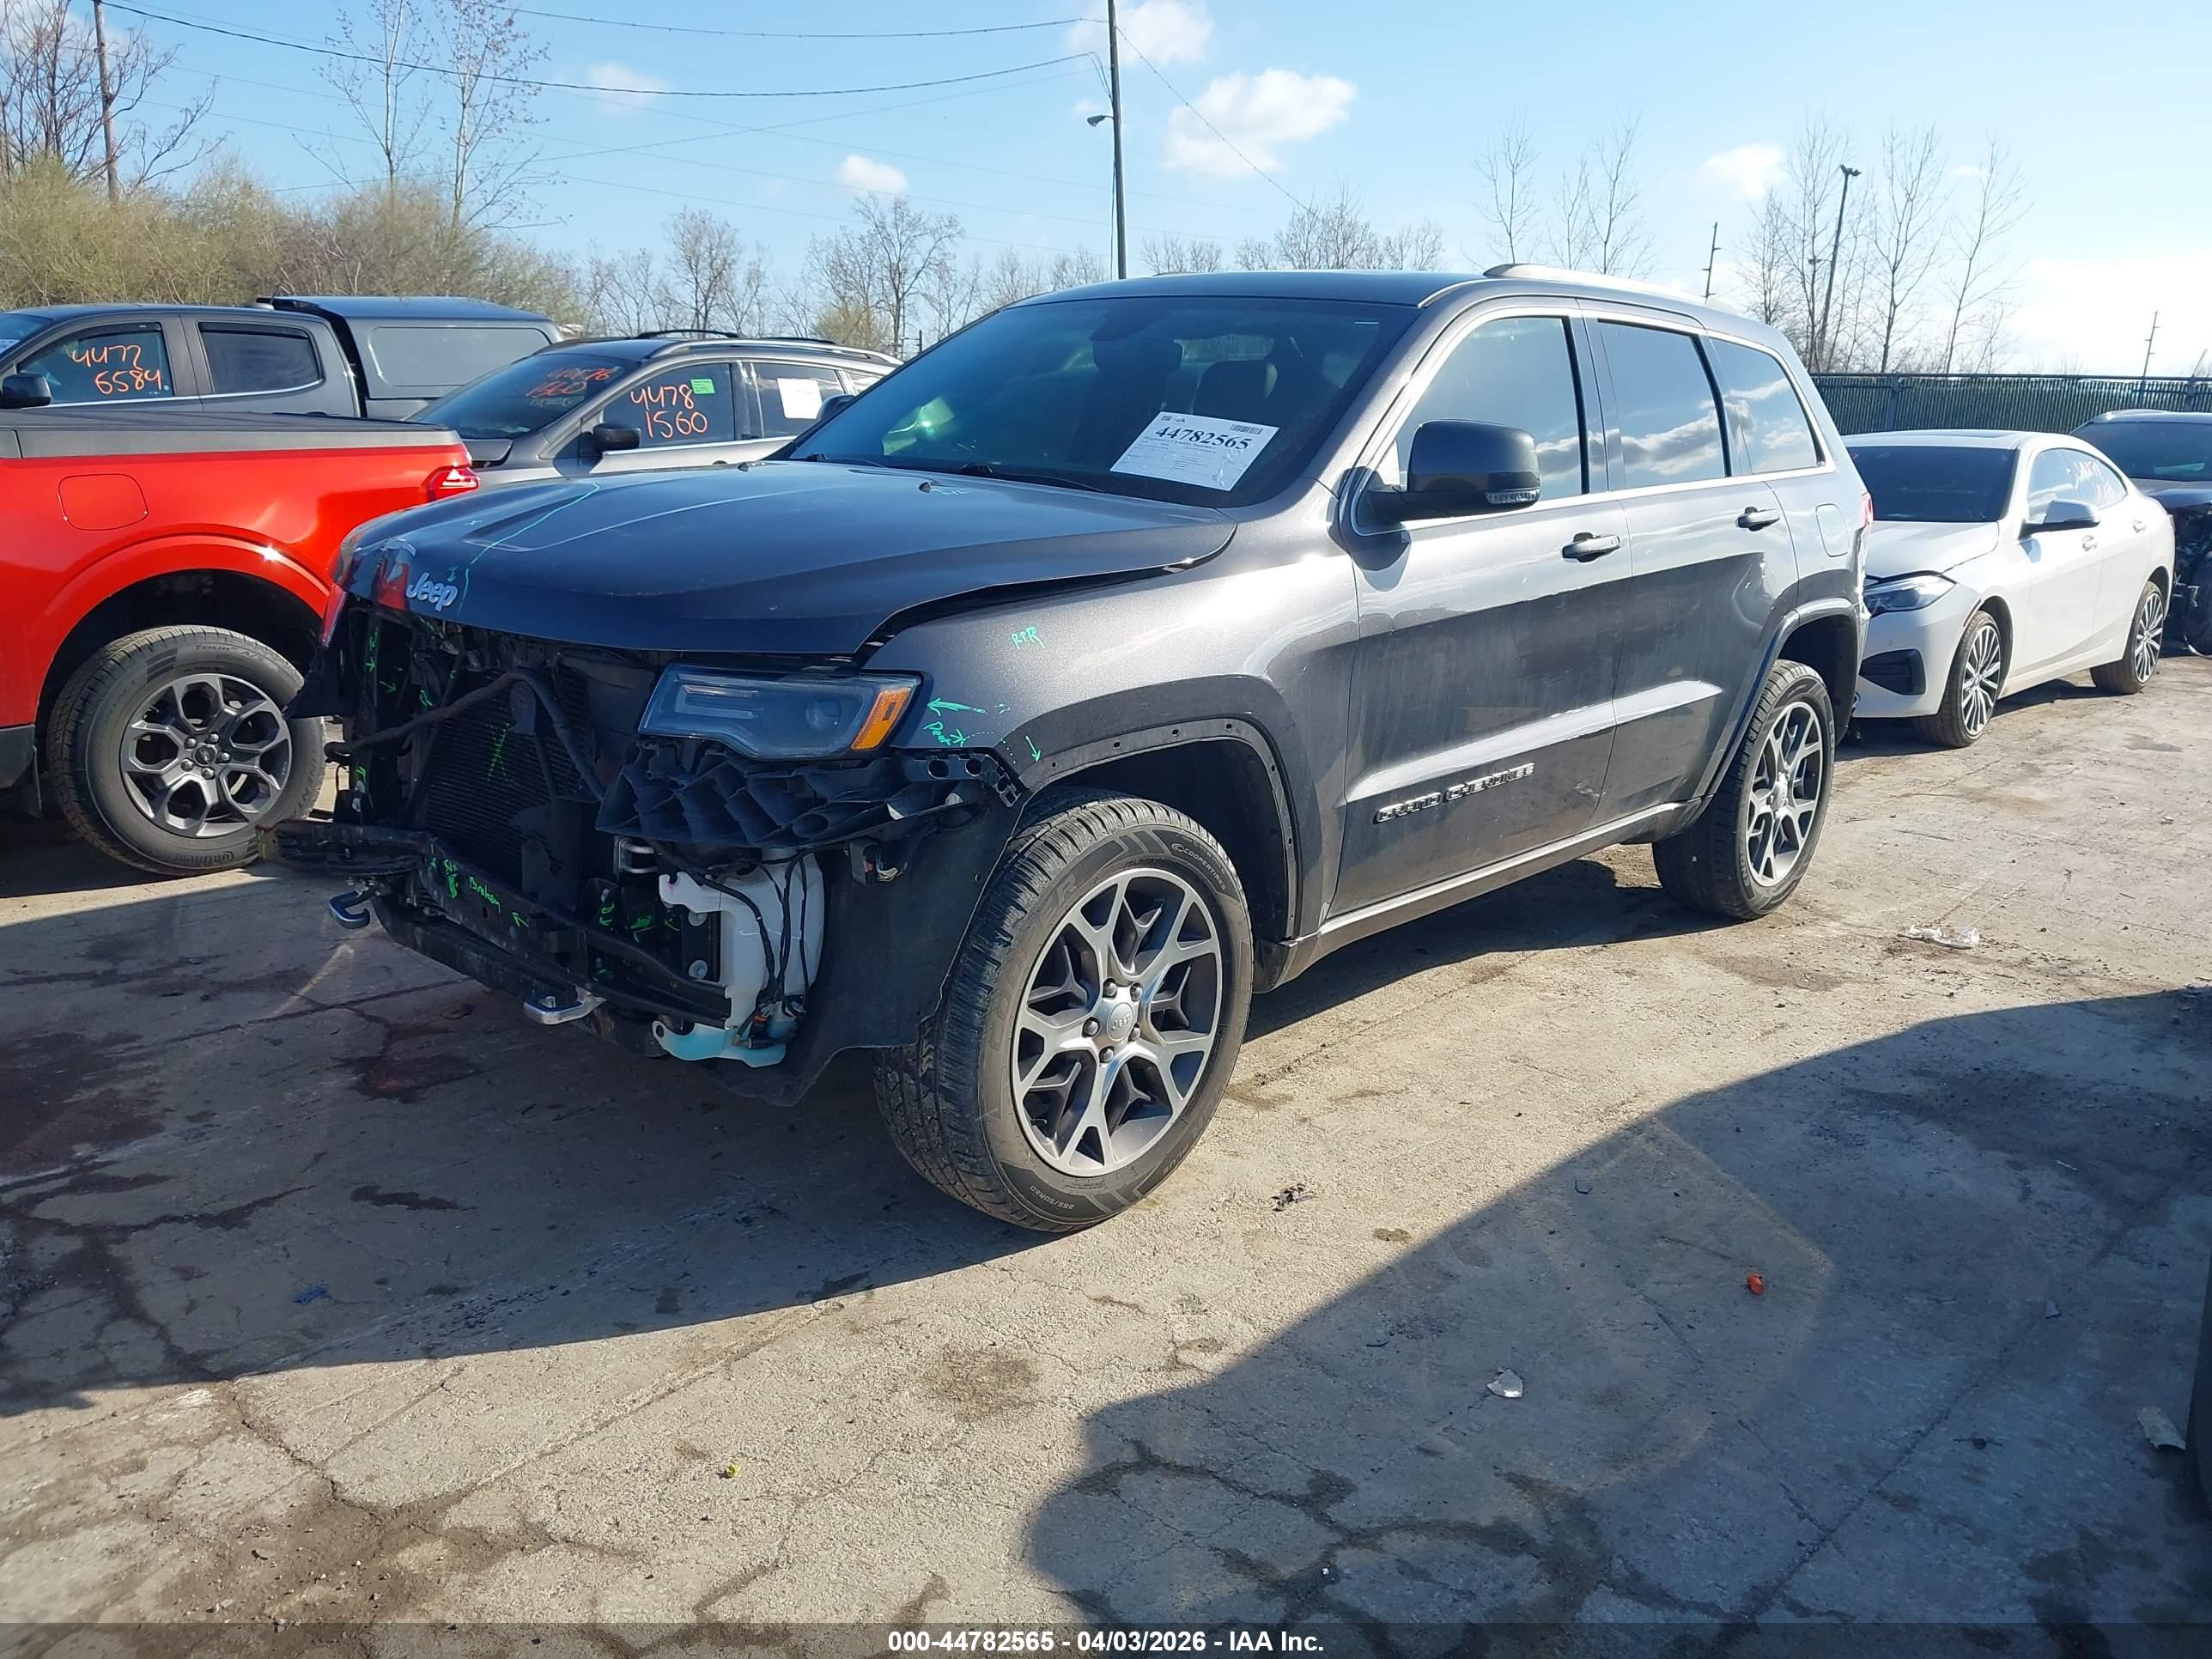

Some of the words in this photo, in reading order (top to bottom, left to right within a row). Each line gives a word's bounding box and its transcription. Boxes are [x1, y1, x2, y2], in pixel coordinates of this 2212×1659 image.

[95, 369, 162, 395] 6584
[630, 384, 695, 411] 4478
[645, 410, 708, 439] 1560
[1155, 426, 1253, 451] 44782565
[405, 572, 459, 612] Jeep
